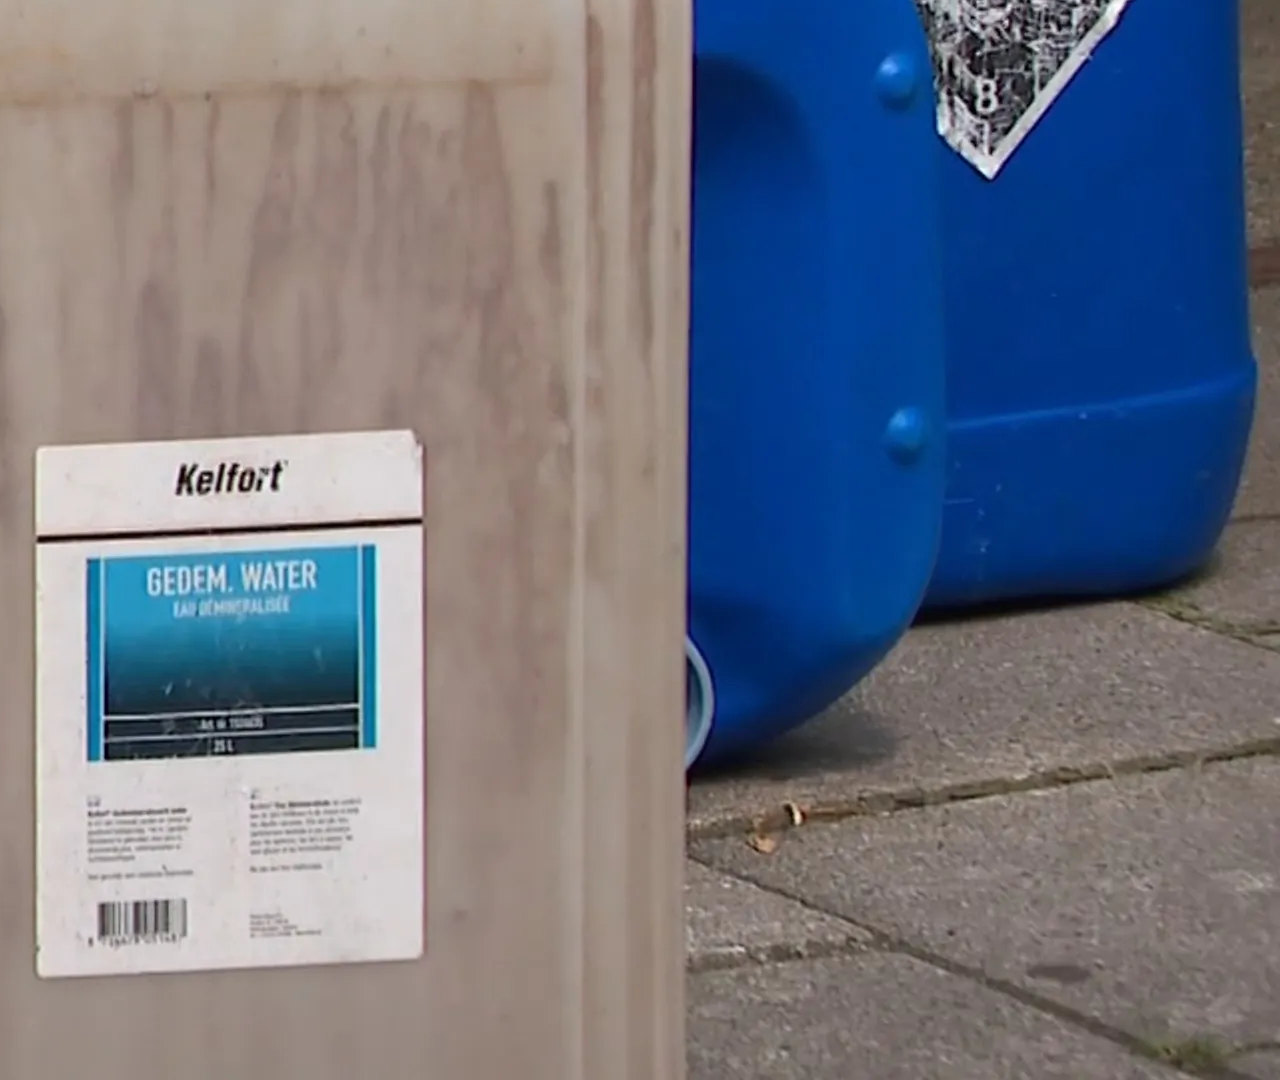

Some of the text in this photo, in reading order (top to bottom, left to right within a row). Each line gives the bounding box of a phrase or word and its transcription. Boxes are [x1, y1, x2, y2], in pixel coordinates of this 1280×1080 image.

[976, 78, 998, 114] 8
[174, 460, 284, 497] Kelfort
[146, 558, 318, 598] GEDEM. WATER
[172, 600, 197, 619] EAU
